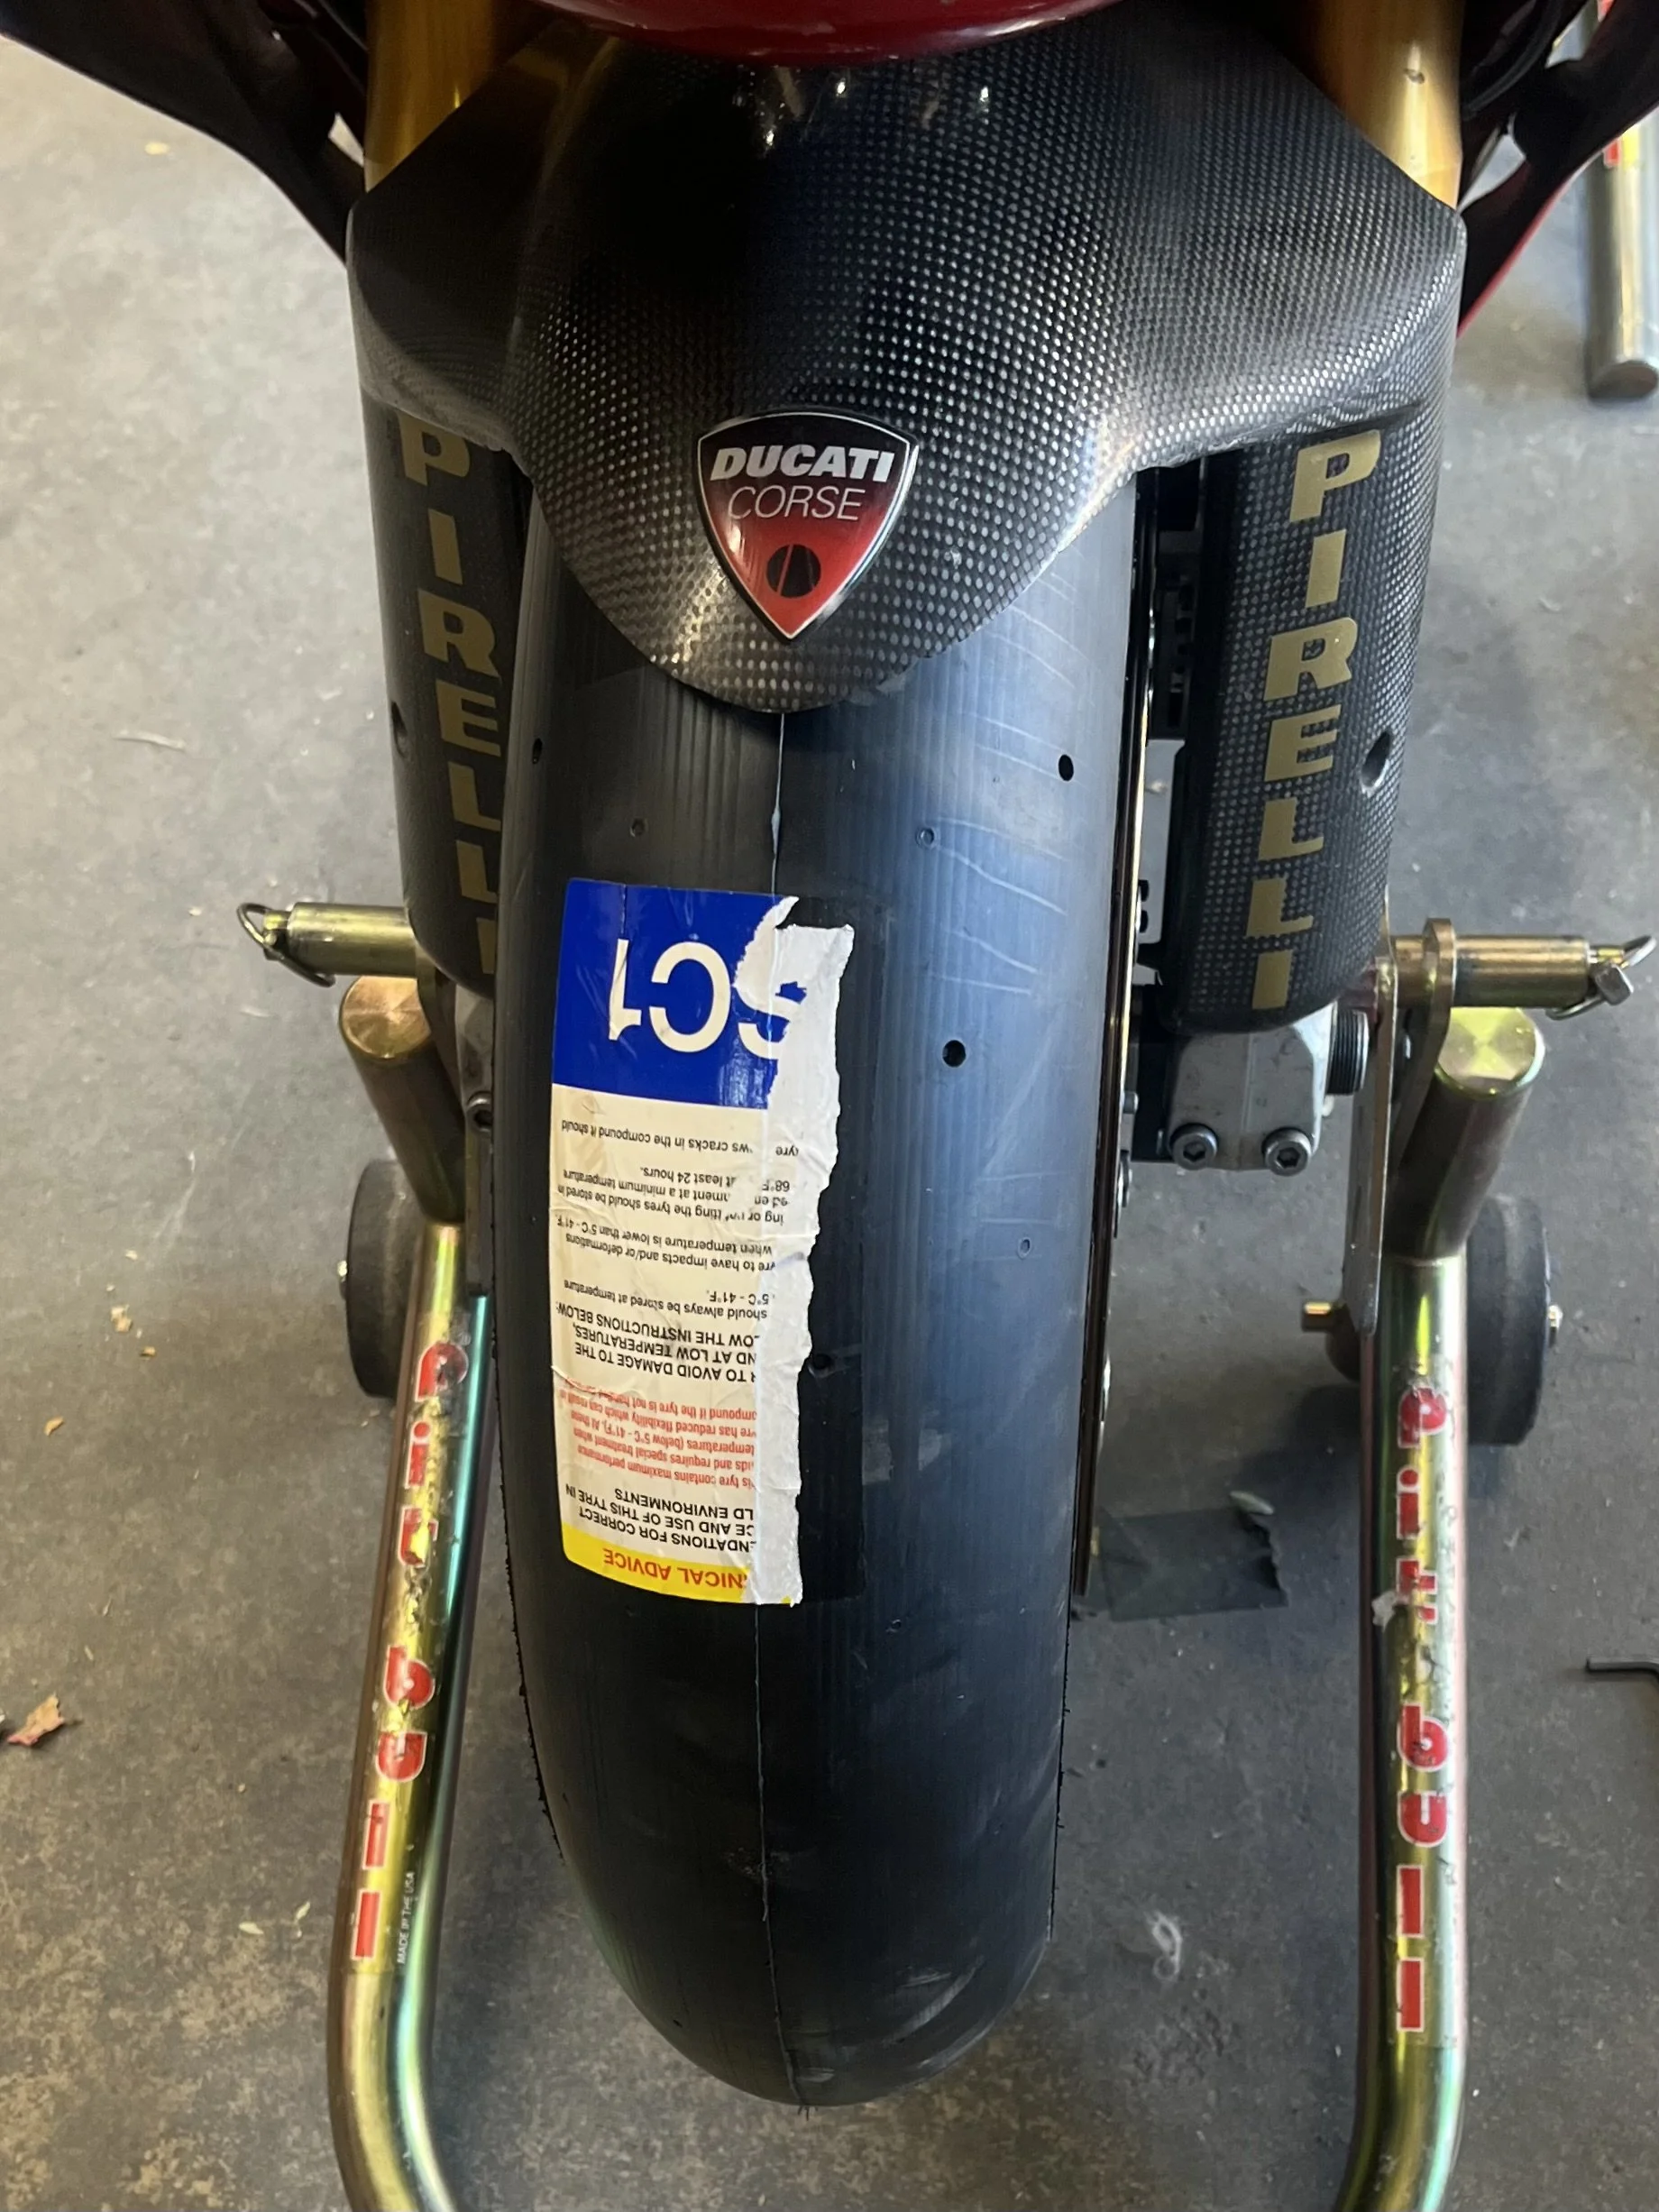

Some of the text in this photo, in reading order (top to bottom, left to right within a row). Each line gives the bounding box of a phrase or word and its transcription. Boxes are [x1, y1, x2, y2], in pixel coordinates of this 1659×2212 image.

[710, 444, 895, 482] DUCATI
[726, 484, 866, 520] CORSE
[1242, 427, 1381, 1010] PIRELLI
[608, 938, 806, 1060] SC1
[562, 1119, 589, 1135] should
[590, 1123, 597, 1136] it
[599, 1125, 651, 1143] compound
[654, 1134, 672, 1148] the
[674, 1136, 685, 1151] in
[688, 1138, 729, 1152] cracks
[563, 1169, 617, 1189] temperature
[640, 1167, 674, 1183] hours.
[677, 1171, 692, 1184] 24
[693, 1173, 723, 1188] least
[565, 1186, 593, 1201] stored
[618, 1179, 666, 1198] minimum
[669, 1188, 676, 1197] a
[678, 1189, 690, 1200] at
[594, 1191, 607, 1206] be
[609, 1196, 641, 1210] should
[644, 1200, 672, 1215] tyres
[674, 1204, 692, 1217] the
[747, 1212, 762, 1223] or
[599, 1225, 620, 1239] than
[621, 1230, 650, 1244] lower
[565, 1233, 623, 1257] deformations
[652, 1235, 663, 1248] is
[665, 1235, 738, 1254] temperature
[625, 1246, 659, 1262] and/or
[740, 1244, 773, 1257] when
[662, 1253, 708, 1270] impacts
[710, 1258, 740, 1272] have
[742, 1260, 756, 1272] to
[564, 1279, 767, 1321] should always be stored at temperature
[555, 1301, 760, 1347] OW THE INSTRUCTIONS BELOW:
[573, 1321, 674, 1358] TEMPERATURES,
[574, 1341, 597, 1360] THE
[598, 1349, 614, 1364] TO
[676, 1345, 709, 1363] LOW
[712, 1351, 732, 1364] AT
[617, 1353, 674, 1375] DAMAGE
[676, 1363, 722, 1381] AVOID
[726, 1368, 747, 1381] TO
[589, 1400, 603, 1413] can
[632, 1397, 646, 1409] not
[648, 1400, 657, 1414] is
[659, 1401, 678, 1417] tyre
[604, 1405, 629, 1421] which
[681, 1405, 697, 1418] the
[700, 1407, 707, 1420] if
[631, 1412, 674, 1434] flexibility
[675, 1421, 716, 1436] reduced
[719, 1427, 738, 1438] has
[594, 1436, 634, 1457] treatment
[652, 1434, 684, 1451] (below
[686, 1439, 755, 1456] temperatures
[577, 1445, 626, 1469] performance
[635, 1446, 667, 1462] special
[670, 1453, 711, 1468] requires
[627, 1461, 672, 1480] maximum
[713, 1458, 733, 1471] and
[674, 1471, 716, 1486] contains
[719, 1474, 739, 1489] tyre
[565, 1483, 576, 1499] IN
[577, 1489, 608, 1511] TYRE
[614, 1488, 754, 1521] LD ENVIRONMENTS
[610, 1501, 639, 1521] THIS
[642, 1512, 661, 1526] OF
[579, 1506, 636, 1536] CORRECT
[665, 1515, 694, 1532] USE
[698, 1521, 731, 1536] AND
[638, 1526, 668, 1543] FOR
[602, 1547, 747, 1589] NICAL ADVICE
[405, 1871, 415, 1894] USA
[402, 1895, 413, 1915] THE
[396, 1931, 410, 1965] MADE
